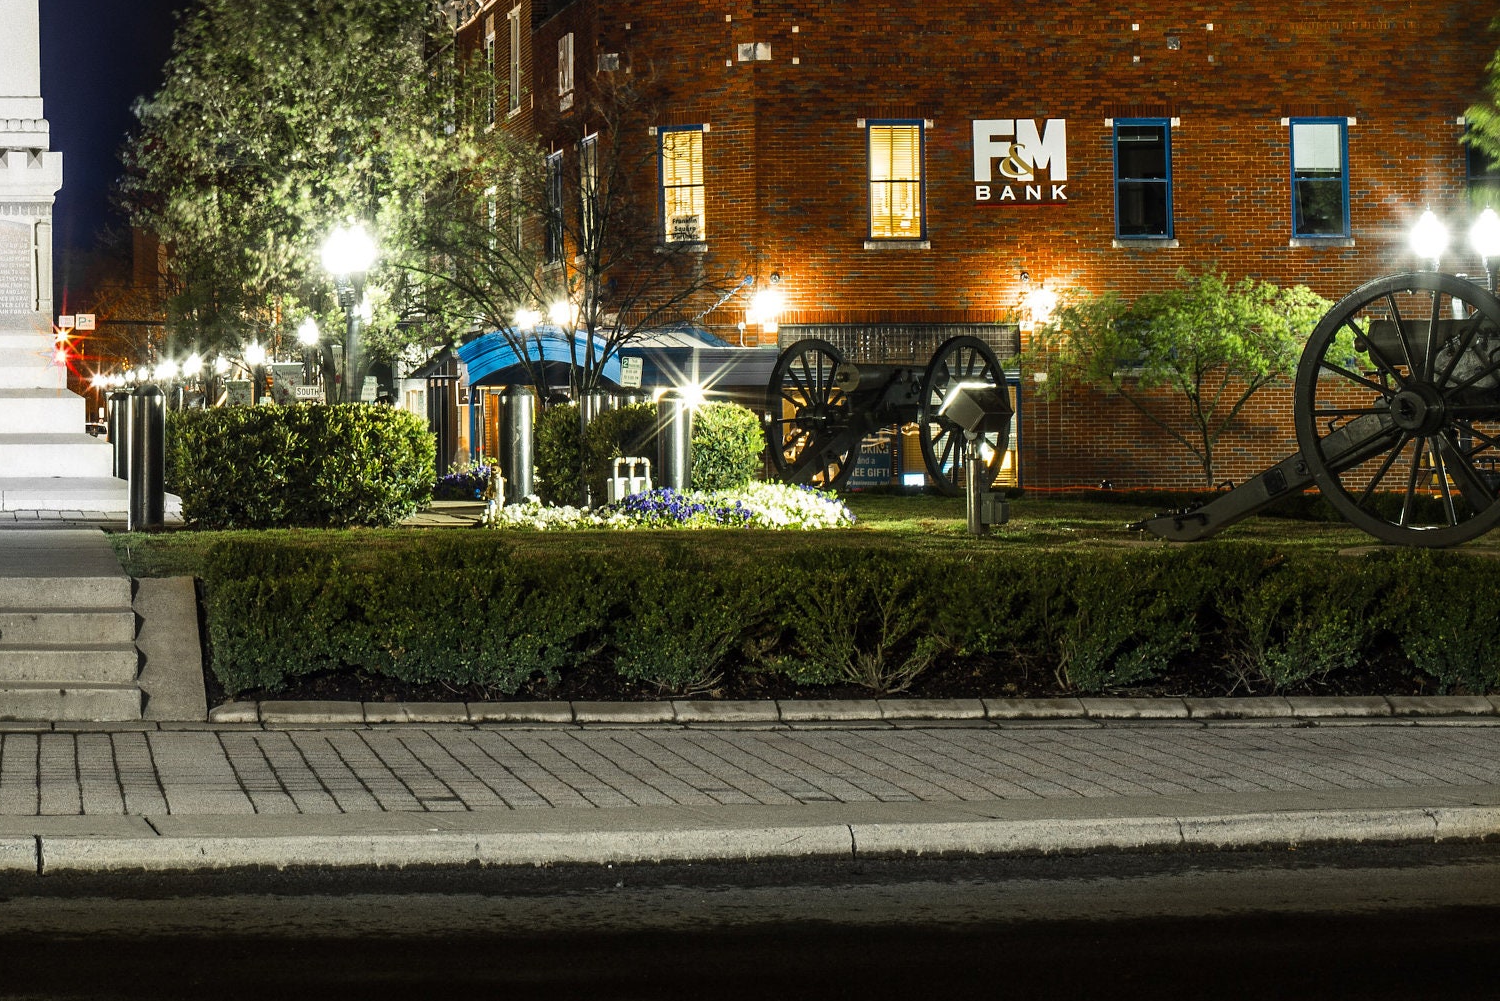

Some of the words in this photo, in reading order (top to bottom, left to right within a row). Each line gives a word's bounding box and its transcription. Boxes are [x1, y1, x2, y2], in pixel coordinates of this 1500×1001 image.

[973, 118, 1068, 181] F&M
[975, 184, 1068, 200] BANK
[296, 387, 319, 395] SOUTH
[852, 467, 865, 477] EE
[867, 467, 890, 477] GIFT!
